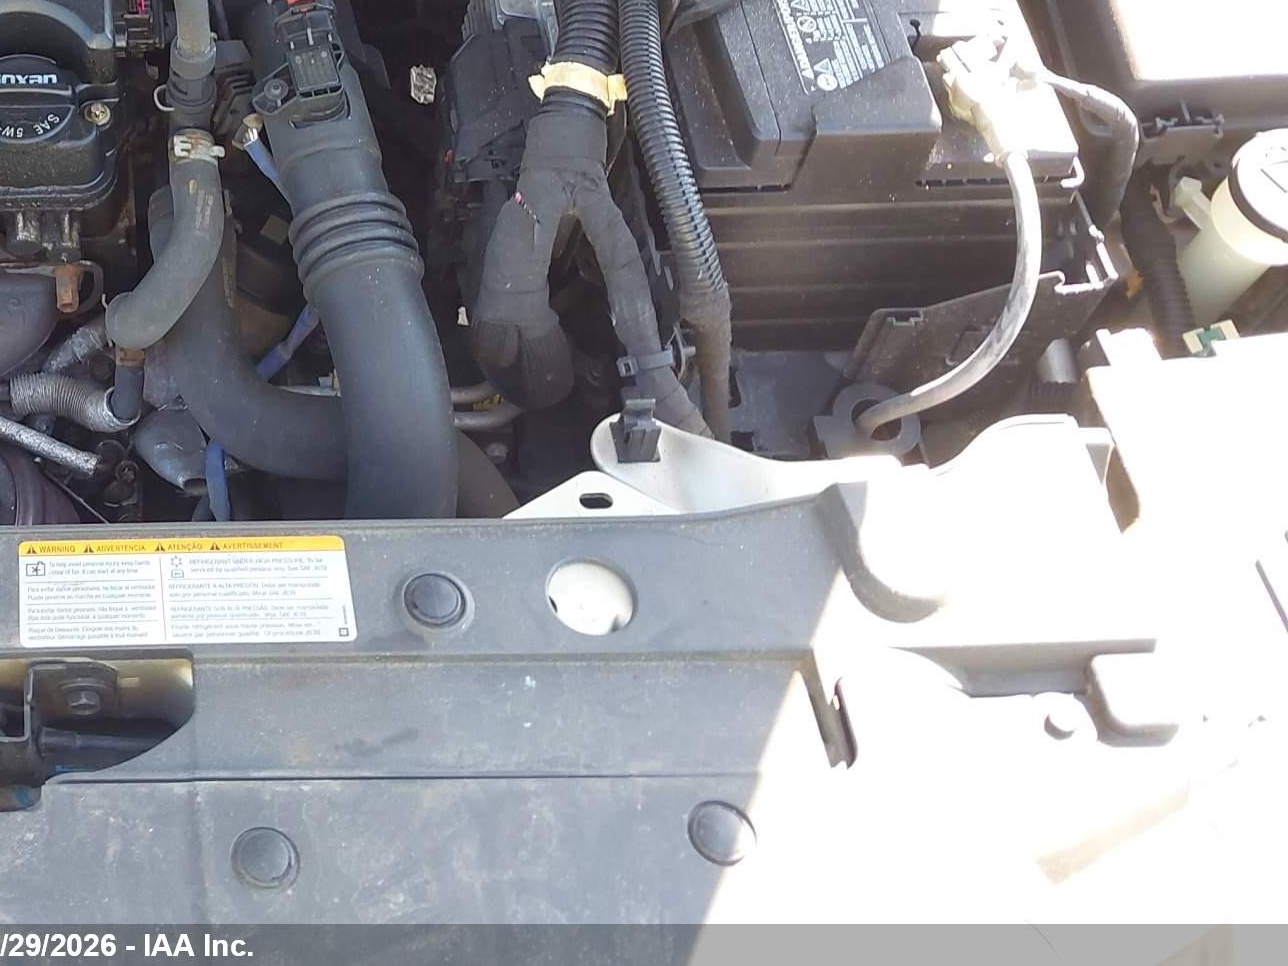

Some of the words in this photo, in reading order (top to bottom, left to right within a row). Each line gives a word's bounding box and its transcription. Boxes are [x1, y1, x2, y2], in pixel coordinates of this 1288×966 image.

[33, 114, 60, 135] SAE
[39, 545, 76, 553] WARNING
[222, 542, 283, 550] AVERTISSEMENT
